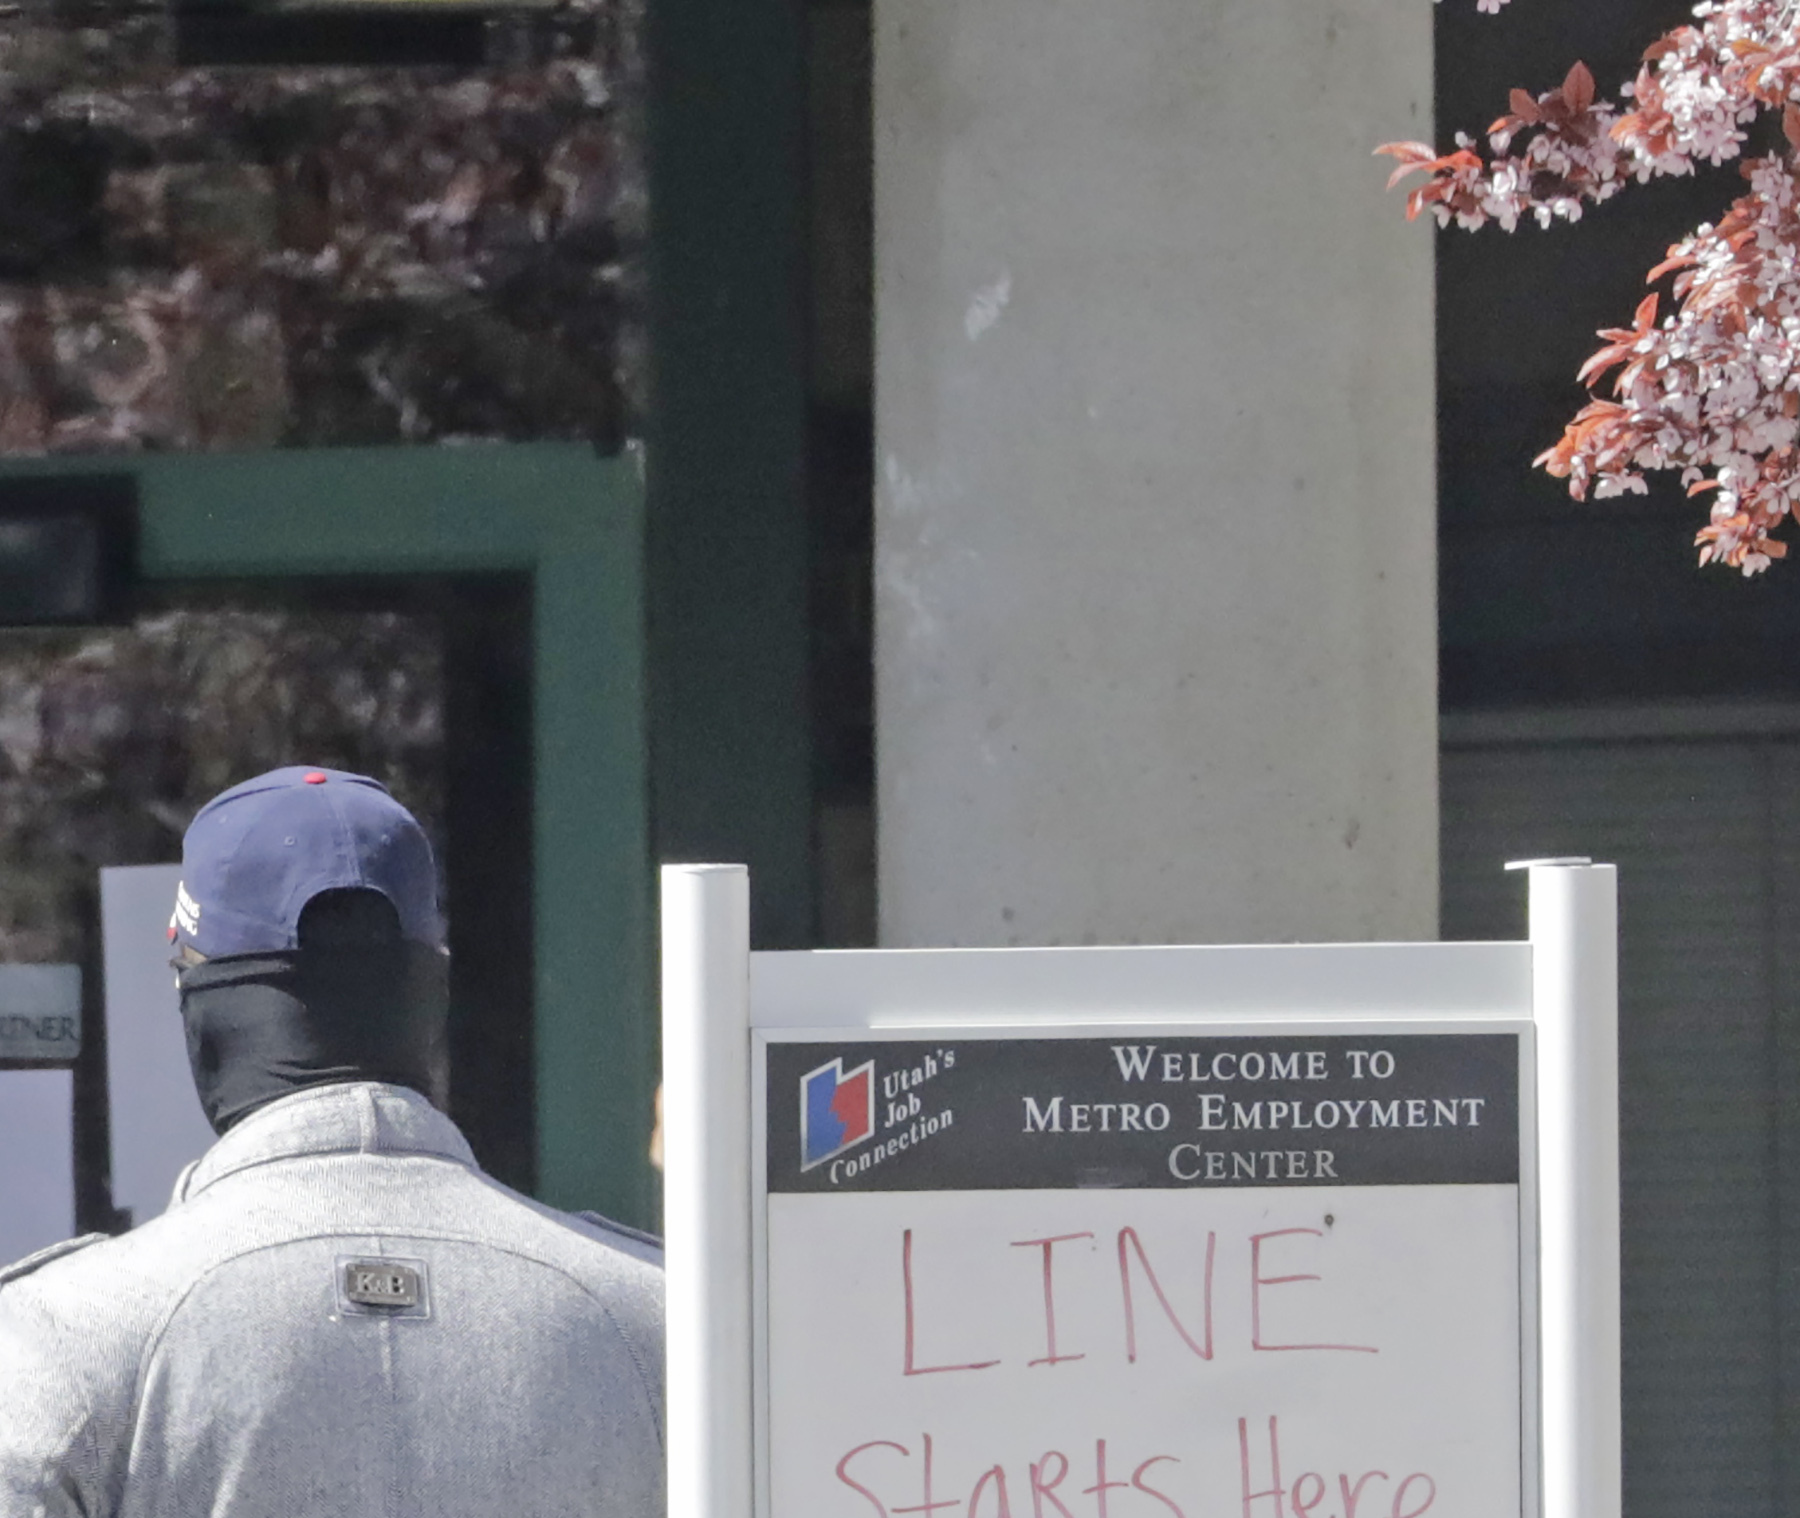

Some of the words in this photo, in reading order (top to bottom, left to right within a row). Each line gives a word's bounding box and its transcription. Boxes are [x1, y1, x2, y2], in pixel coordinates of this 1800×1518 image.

[883, 1048, 956, 1099] Utah's
[1110, 1044, 1329, 1083] WELCOME
[1346, 1050, 1396, 1080] TO
[884, 1092, 922, 1129] Job
[1021, 1096, 1171, 1134] METRO
[1197, 1093, 1486, 1131] EMPLOYMENT
[829, 1107, 954, 1185] Connection
[1167, 1143, 1339, 1181] CENTER
[902, 1226, 1380, 1377] LINE
